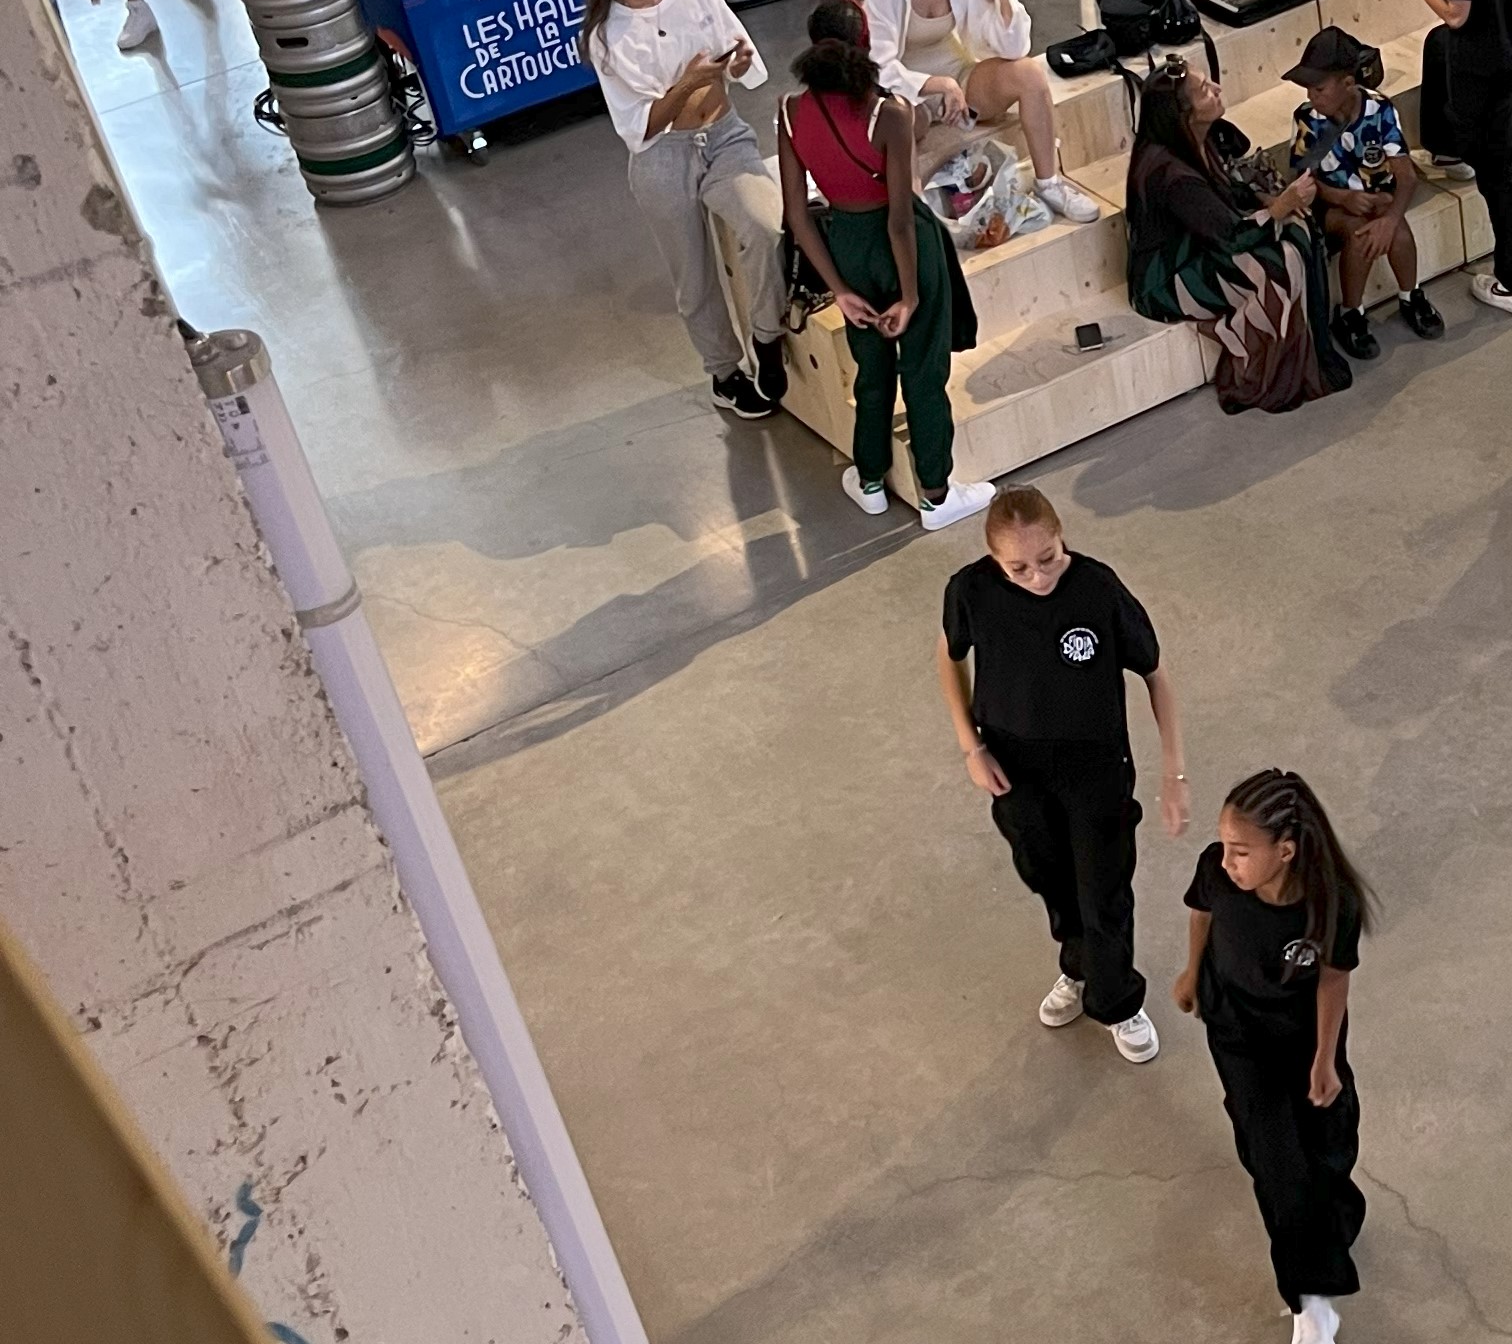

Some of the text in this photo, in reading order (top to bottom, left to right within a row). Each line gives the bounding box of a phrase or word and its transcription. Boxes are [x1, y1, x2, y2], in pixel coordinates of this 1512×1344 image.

[462, 11, 514, 49] LES
[475, 22, 561, 68] DE LA
[460, 36, 582, 99] CARTOUCH
